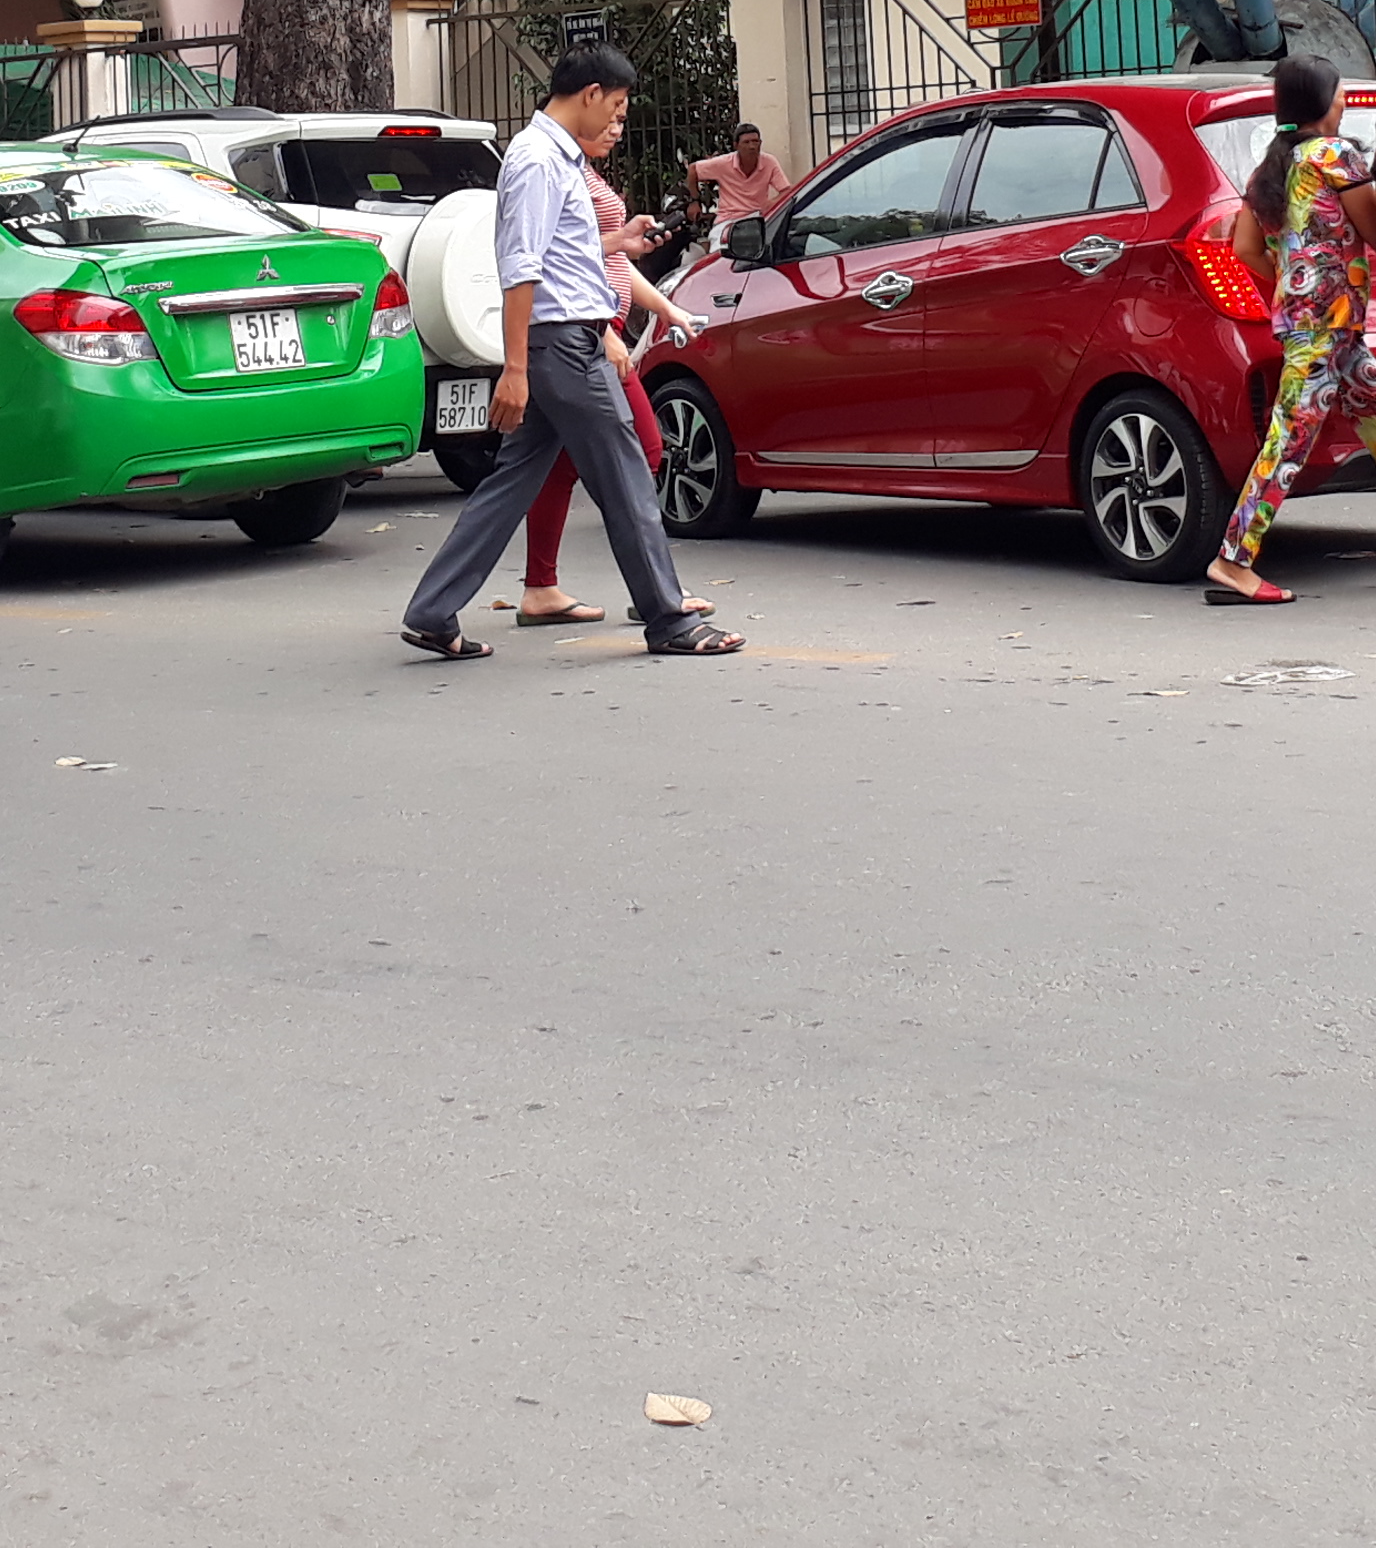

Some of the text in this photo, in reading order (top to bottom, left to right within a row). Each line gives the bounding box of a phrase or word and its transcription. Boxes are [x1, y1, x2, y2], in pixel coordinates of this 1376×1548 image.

[2, 211, 62, 229] TAXI
[245, 312, 282, 340] 51F
[236, 338, 303, 368] 544.42
[450, 383, 478, 406] 51F
[438, 405, 487, 429] 587.10
